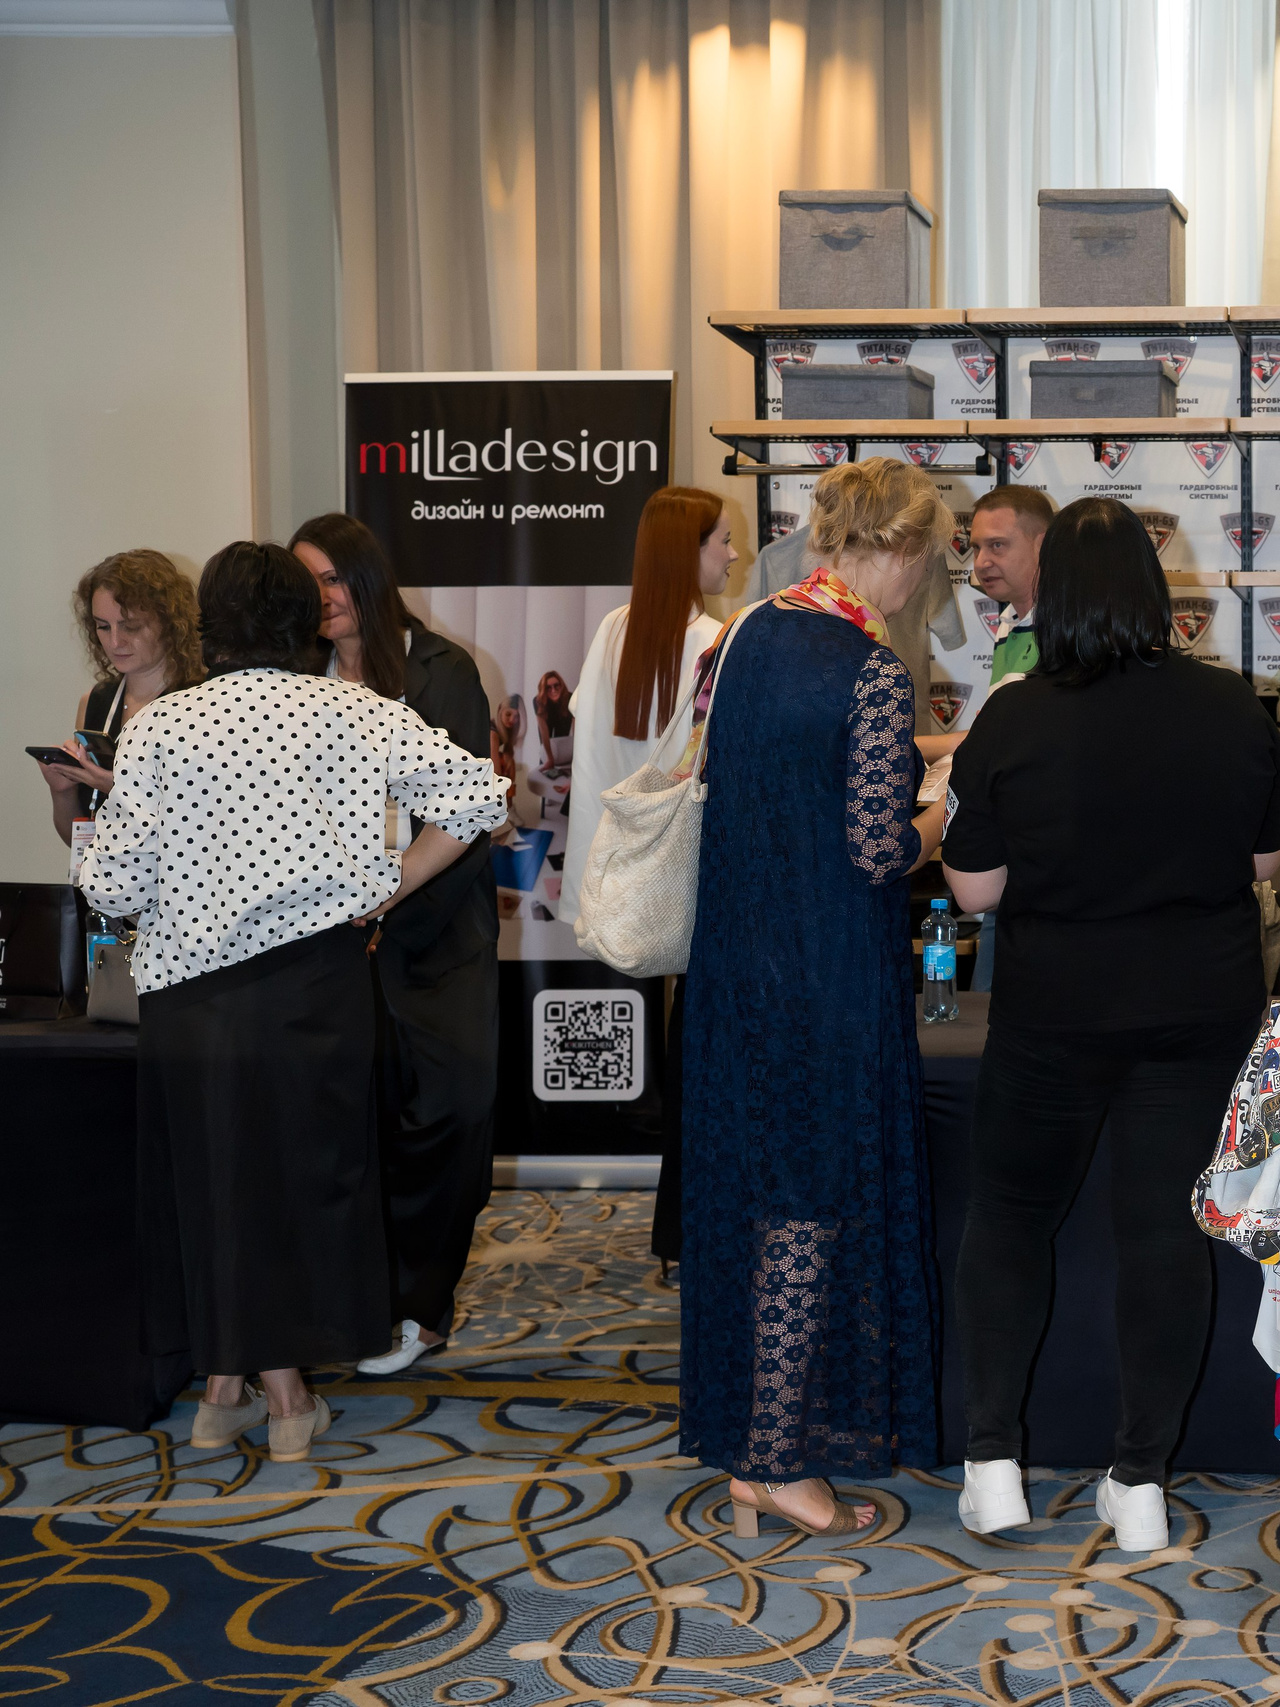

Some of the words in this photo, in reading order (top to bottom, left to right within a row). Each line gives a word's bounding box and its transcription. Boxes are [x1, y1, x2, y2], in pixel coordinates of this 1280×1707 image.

[861, 343, 907, 356] ТИТАН-GS
[1050, 342, 1096, 354] ТИТАН-GS
[359, 427, 658, 485] milladesign
[411, 498, 485, 520] дизайн
[491, 504, 504, 519] и
[511, 503, 605, 525] ремонт
[1141, 514, 1175, 527] ТАН-GS
